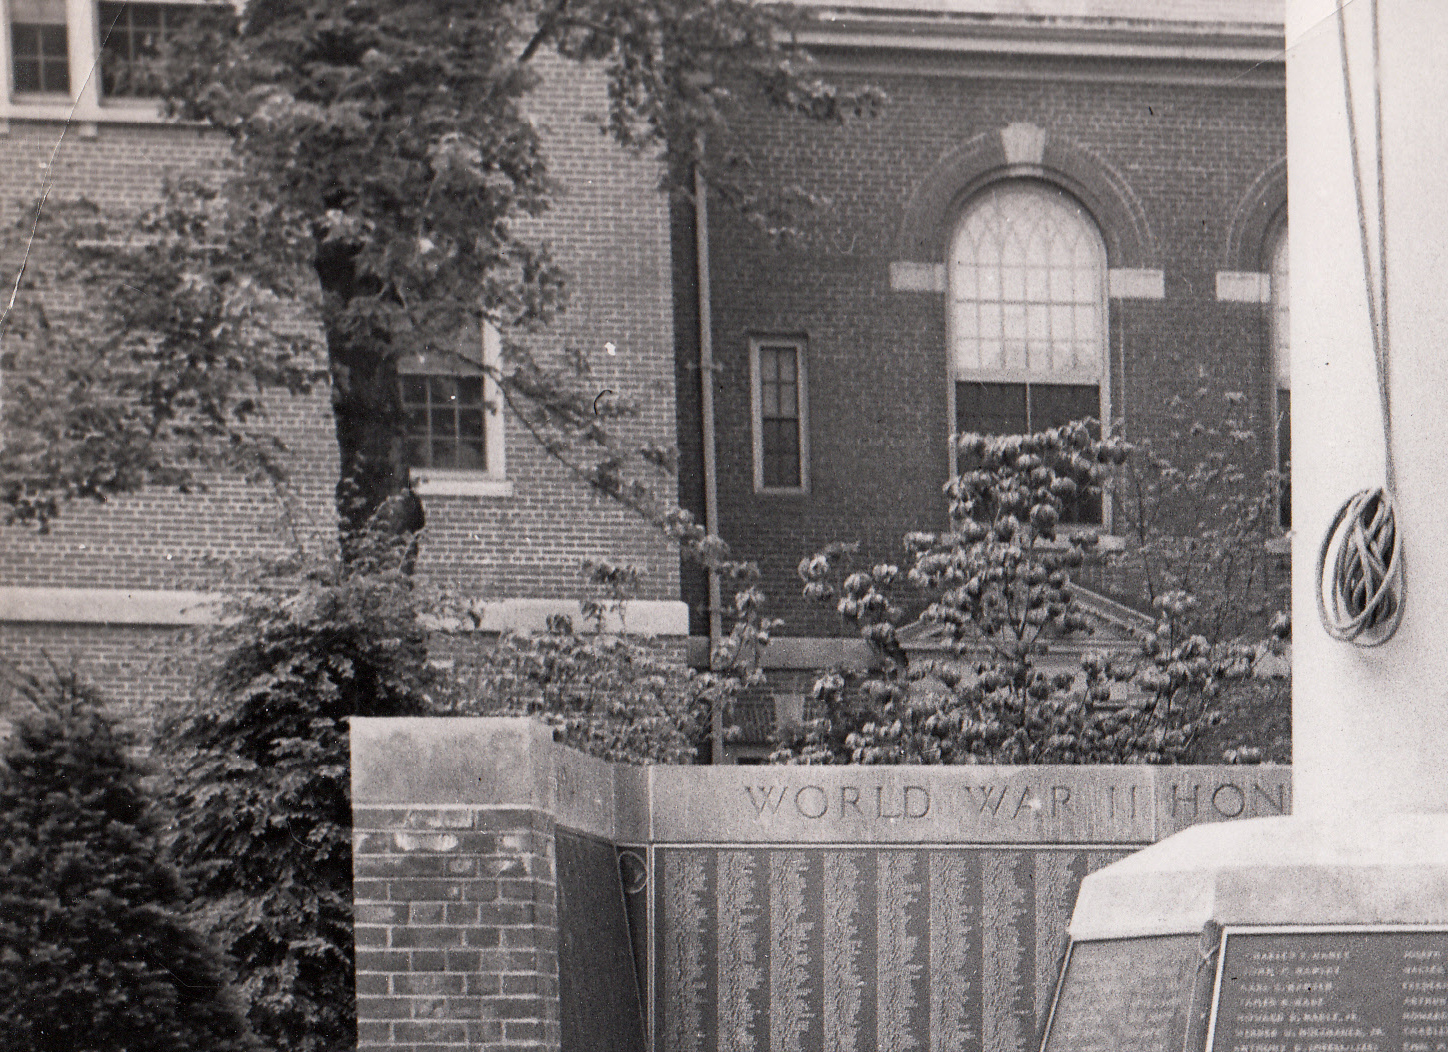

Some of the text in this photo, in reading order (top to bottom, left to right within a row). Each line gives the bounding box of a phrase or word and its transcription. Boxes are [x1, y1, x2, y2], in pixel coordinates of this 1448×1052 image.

[744, 785, 931, 819] WORLD
[964, 785, 1073, 819] WAR
[1109, 785, 1137, 819] II
[1171, 783, 1285, 818] HON
